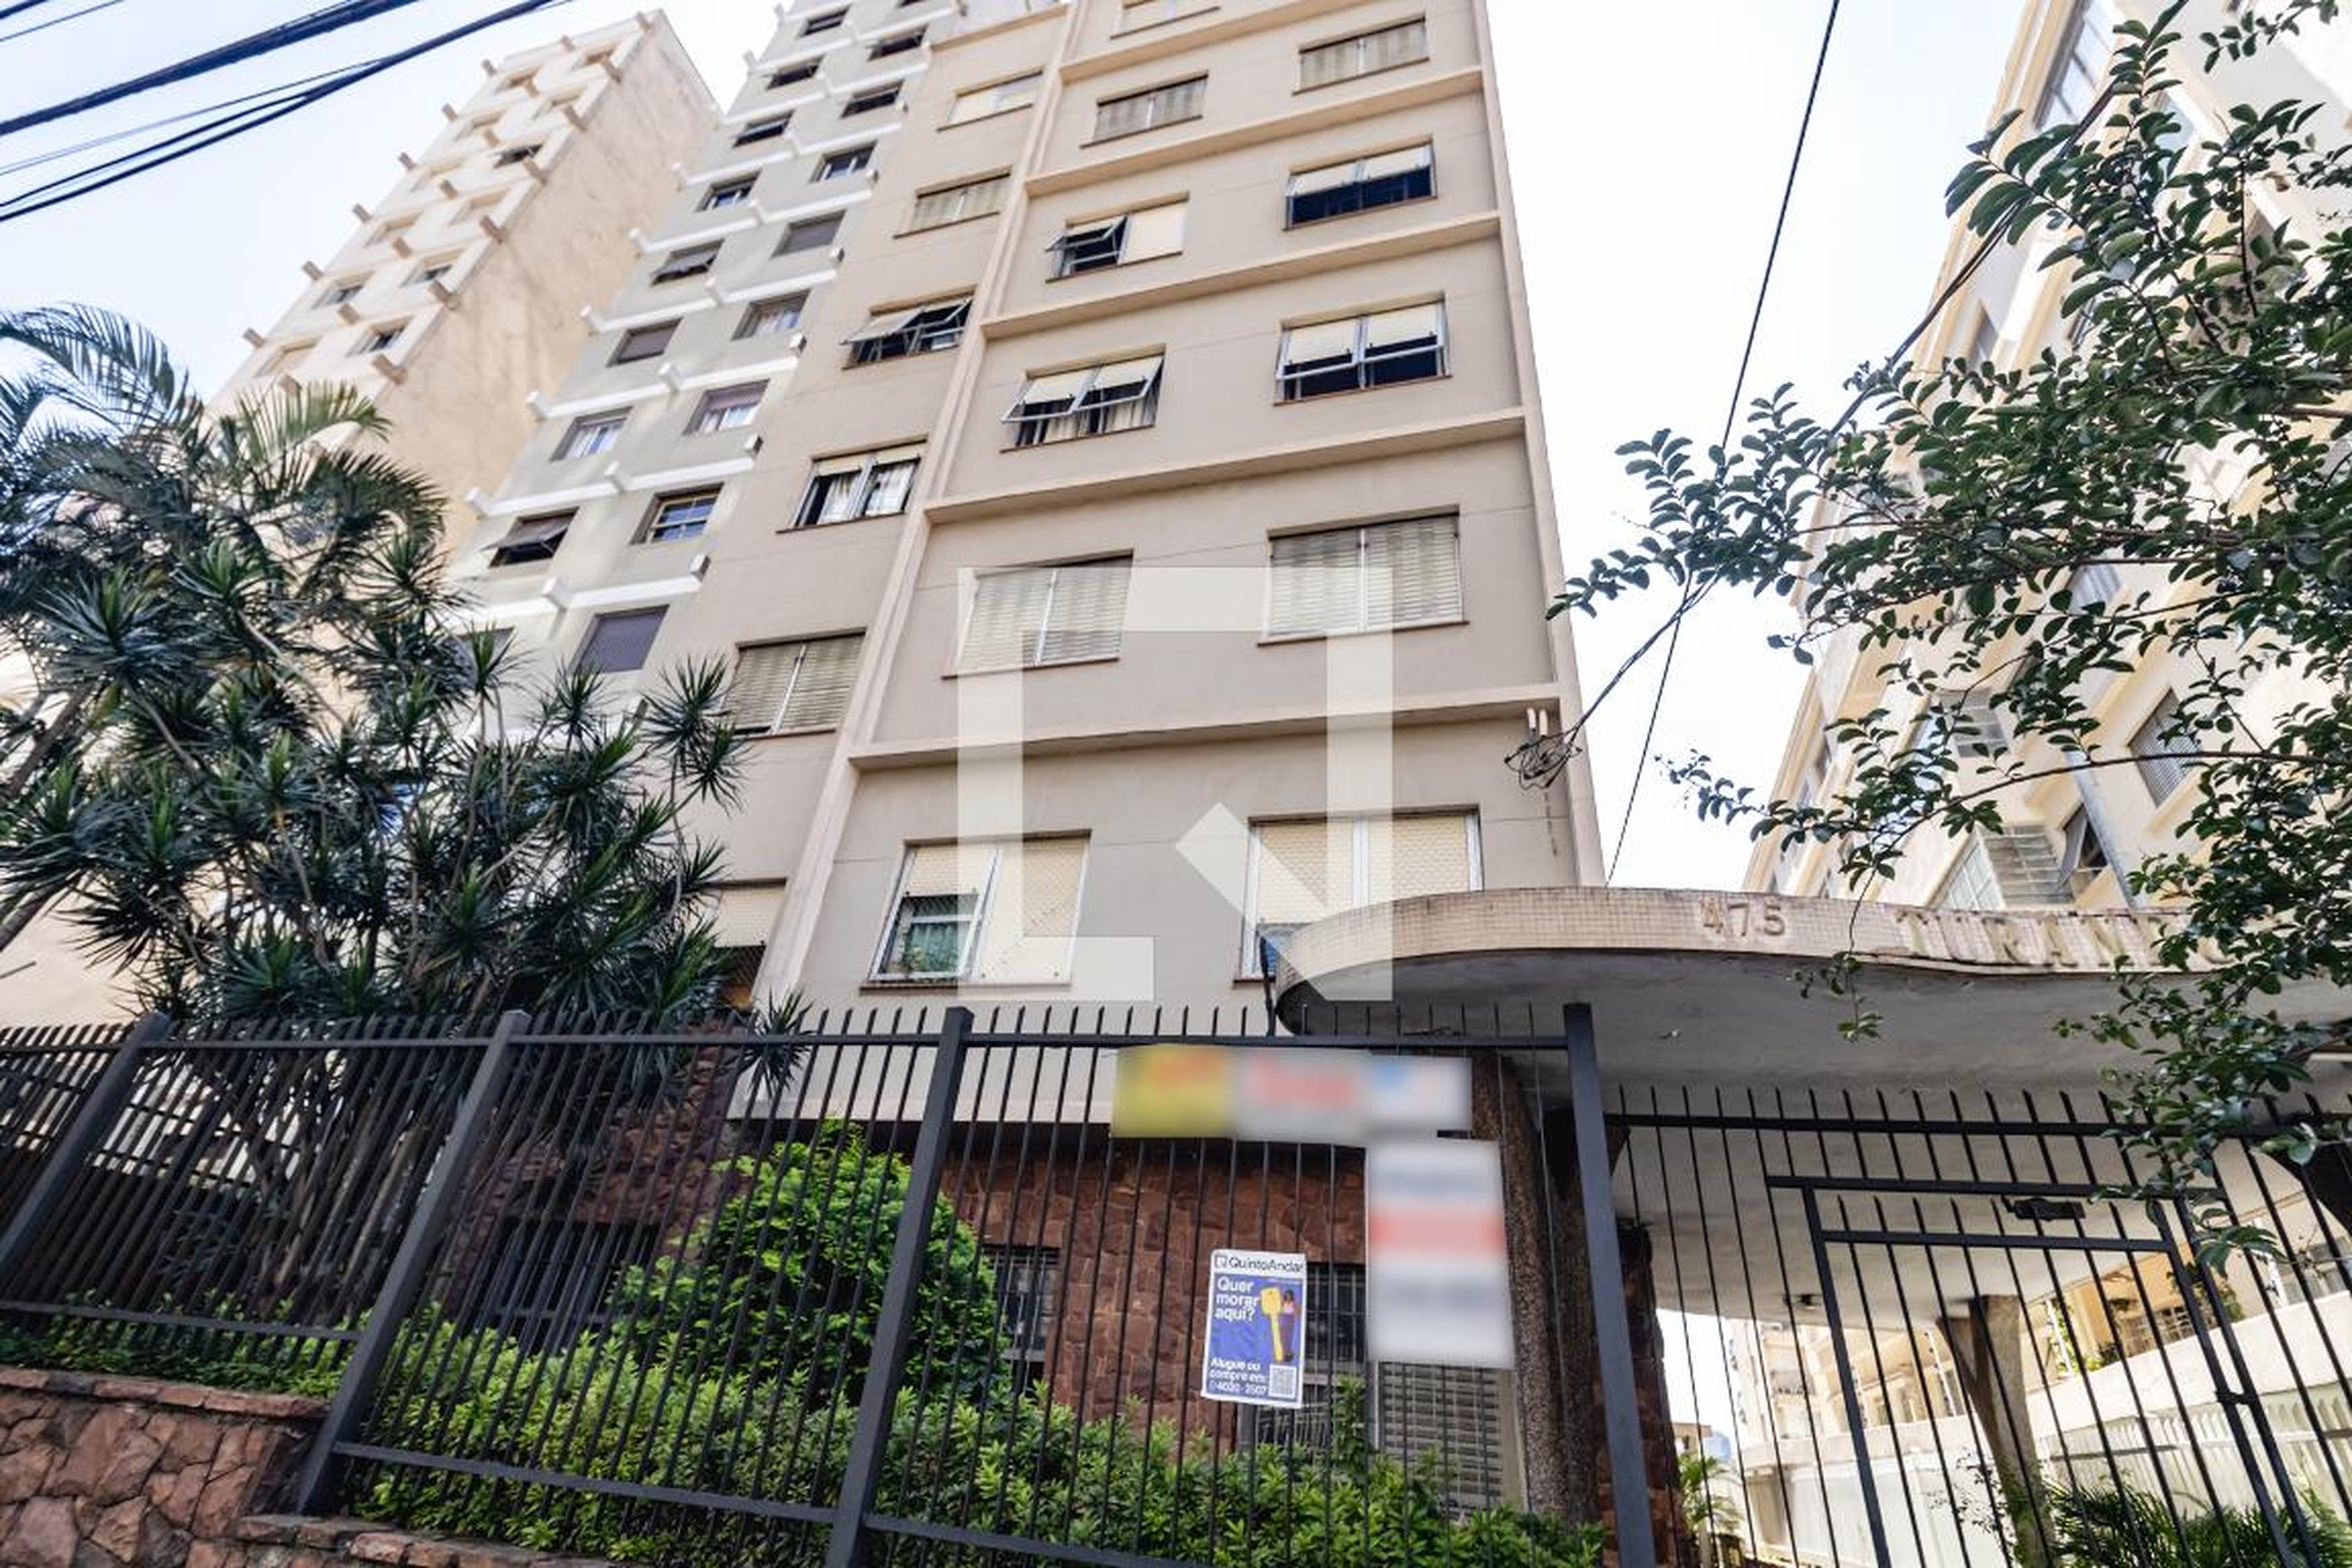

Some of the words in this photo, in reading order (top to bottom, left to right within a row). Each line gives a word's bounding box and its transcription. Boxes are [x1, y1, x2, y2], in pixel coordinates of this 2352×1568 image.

[1699, 895, 1785, 937] 475
[1229, 1257, 1303, 1272] QuintoAndar
[1218, 1276, 1254, 1293] Quer
[1216, 1293, 1259, 1307] morar
[1214, 1306, 1256, 1323] aqui?
[1210, 1357, 1245, 1371] Alugue
[1247, 1360, 1261, 1371] ou
[1209, 1369, 1248, 1382] compre
